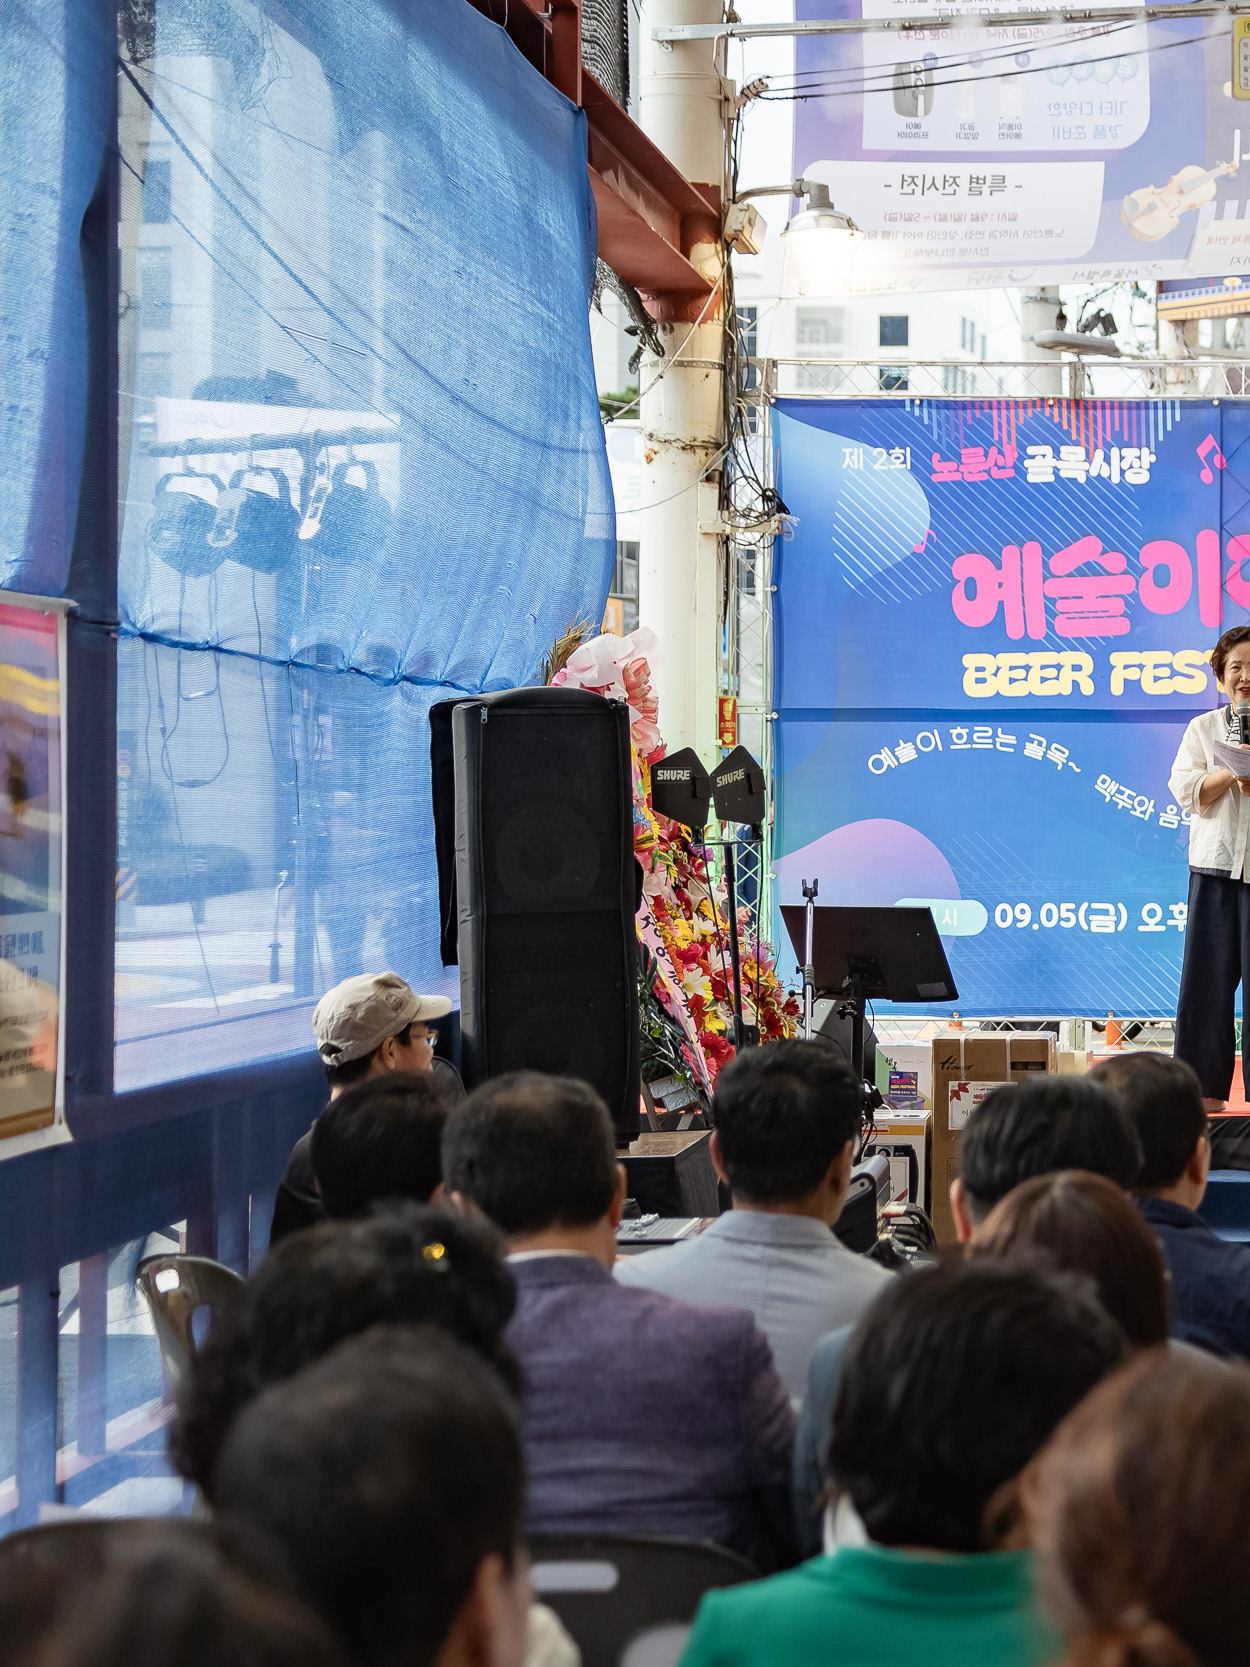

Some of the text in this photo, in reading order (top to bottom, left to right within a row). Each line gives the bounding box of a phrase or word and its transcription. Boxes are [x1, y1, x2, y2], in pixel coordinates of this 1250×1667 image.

[841, 444, 1157, 485] 제 2회 노룬산 골목시장
[962, 648, 1095, 698] BEER
[867, 727, 943, 775] 예술이
[948, 725, 1018, 753] 흐르는
[656, 768, 691, 781] SHURE
[716, 768, 745, 788] SHURE
[1093, 772, 1156, 821] 맥주와
[993, 902, 1128, 933] 09.05(금)
